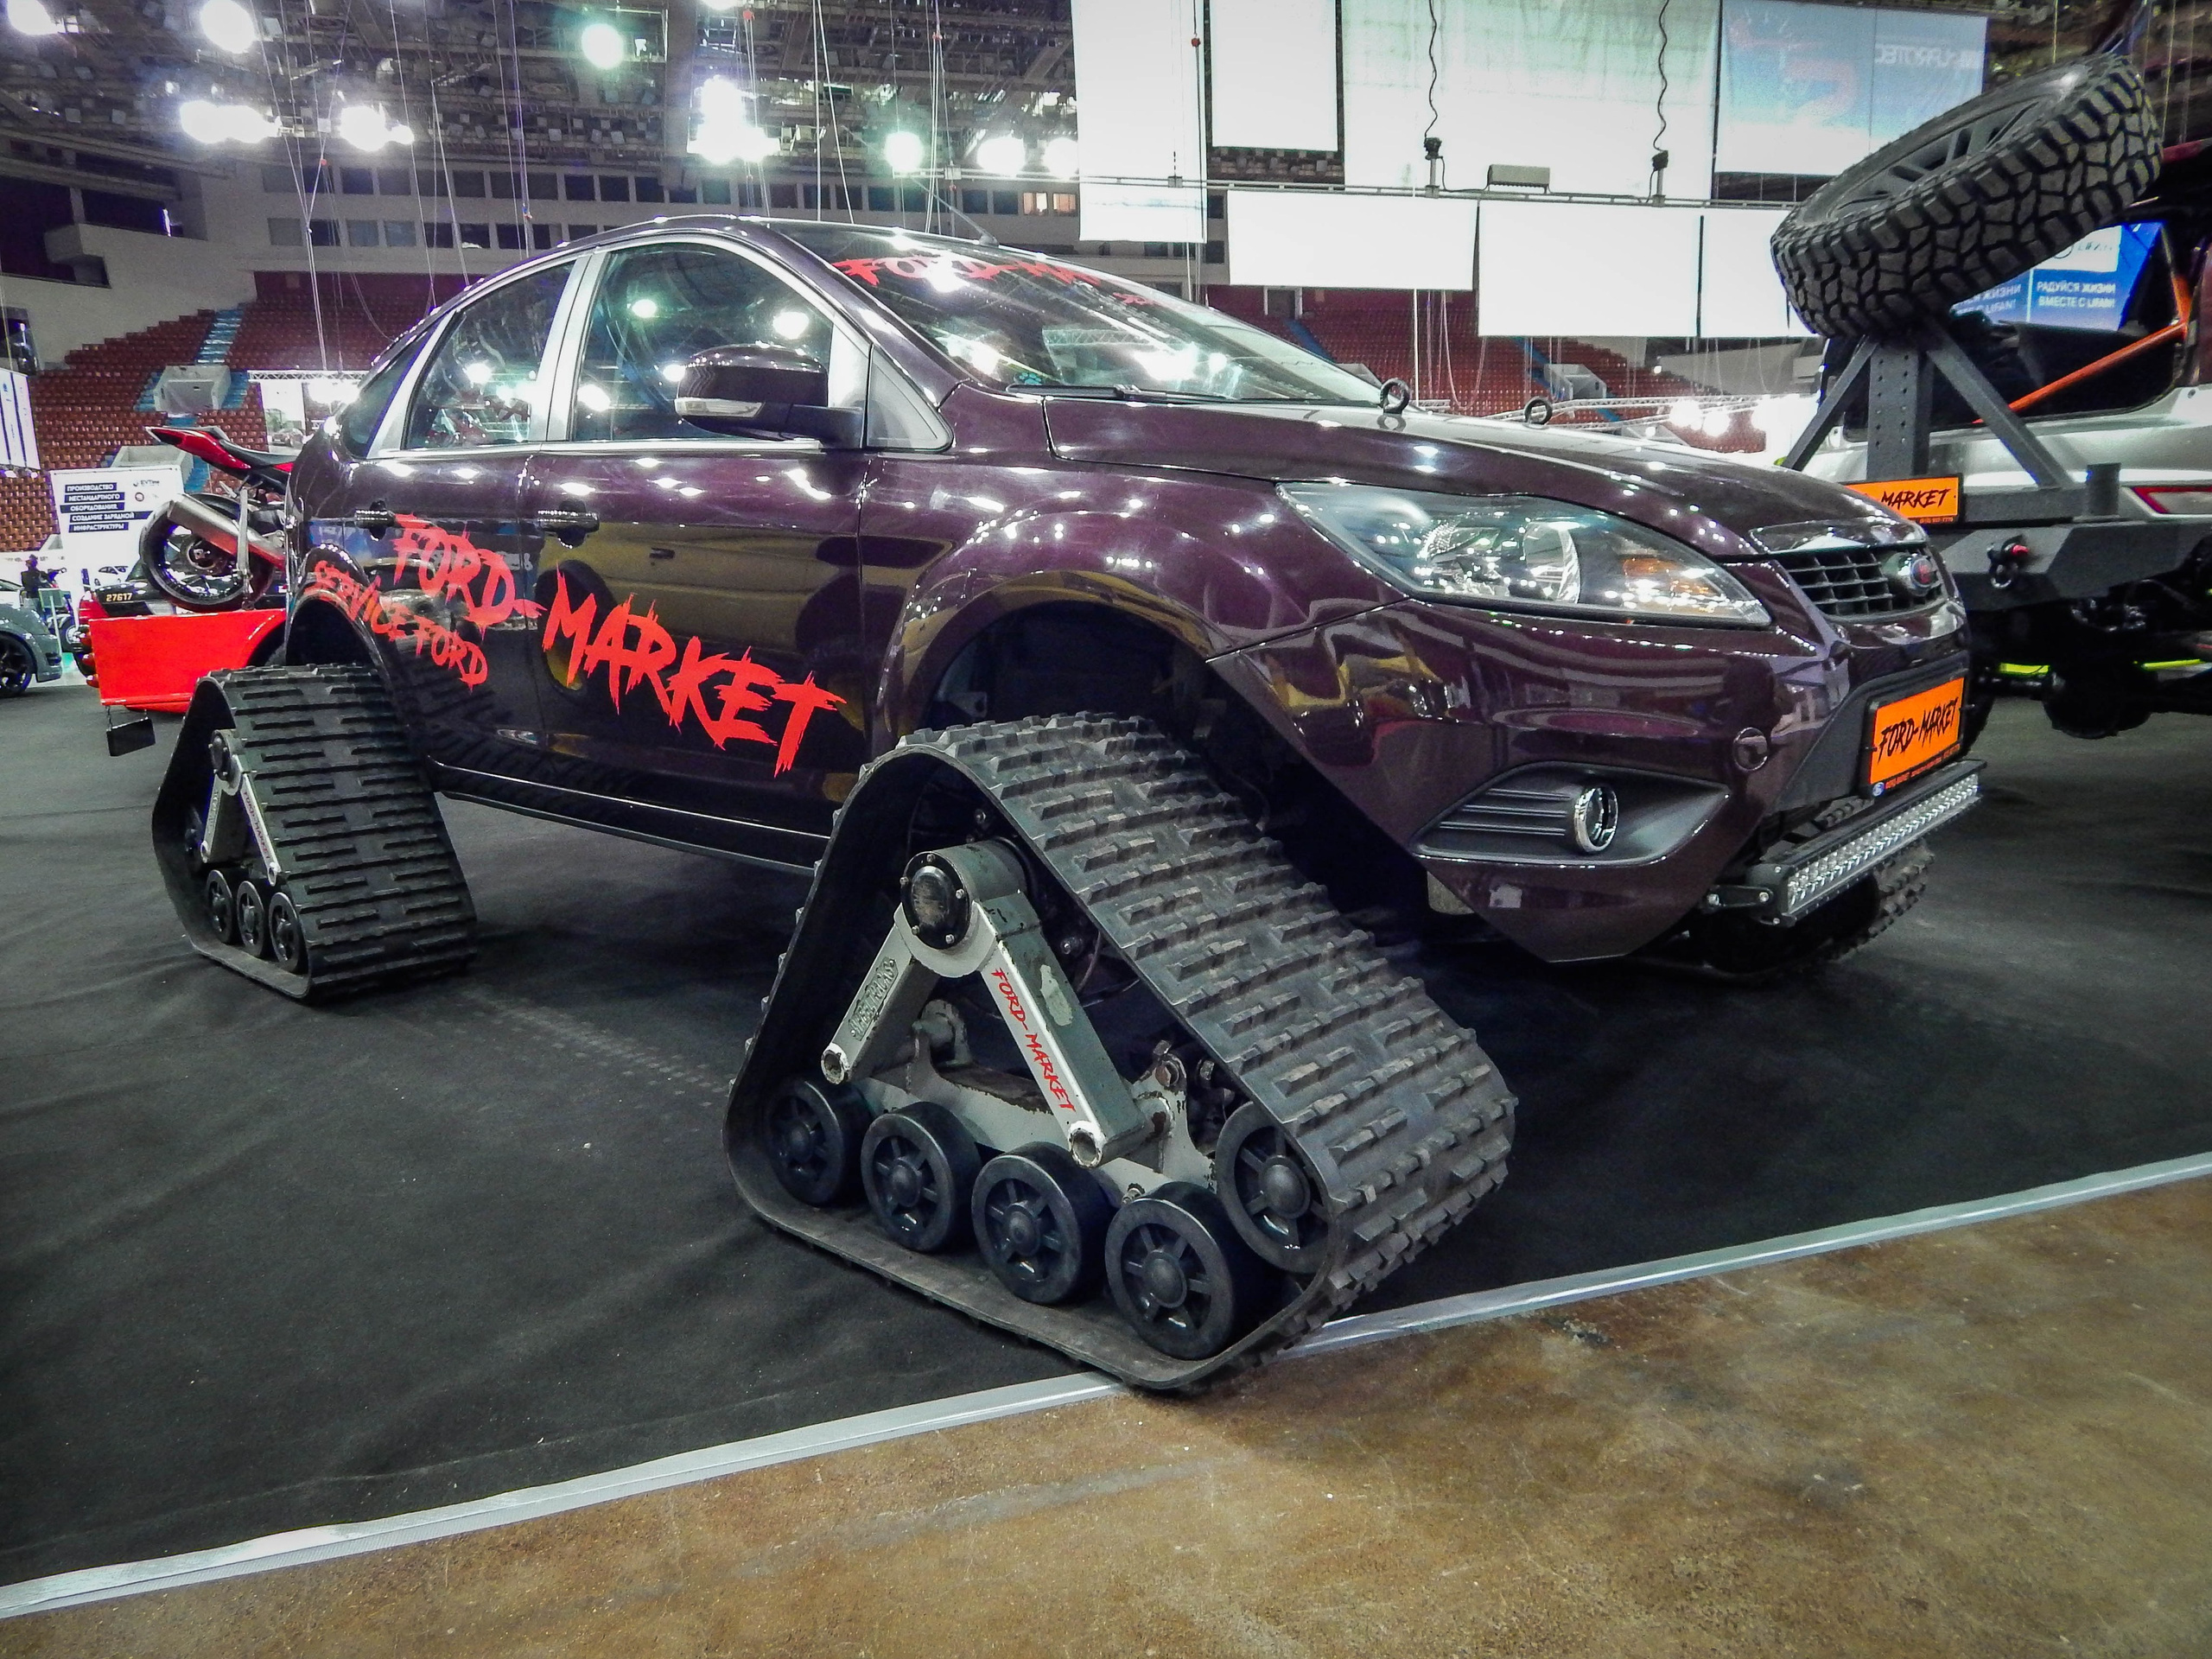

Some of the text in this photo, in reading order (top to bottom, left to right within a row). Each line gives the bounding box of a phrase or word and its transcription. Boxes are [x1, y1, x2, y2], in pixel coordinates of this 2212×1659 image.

[2037, 280, 2116, 294] РАДУЙСЯ ЖИЗНИ
[2038, 296, 2077, 308] ВМЕСТЕ
[68, 493, 121, 502] НЕСТАНДАРТНОГО
[104, 512, 135, 520] ЗАРЯДНОЙ
[73, 523, 124, 531] ИНФРАСТРУКТУРЫ
[106, 593, 133, 601] 27617
[413, 615, 488, 695] FORD
